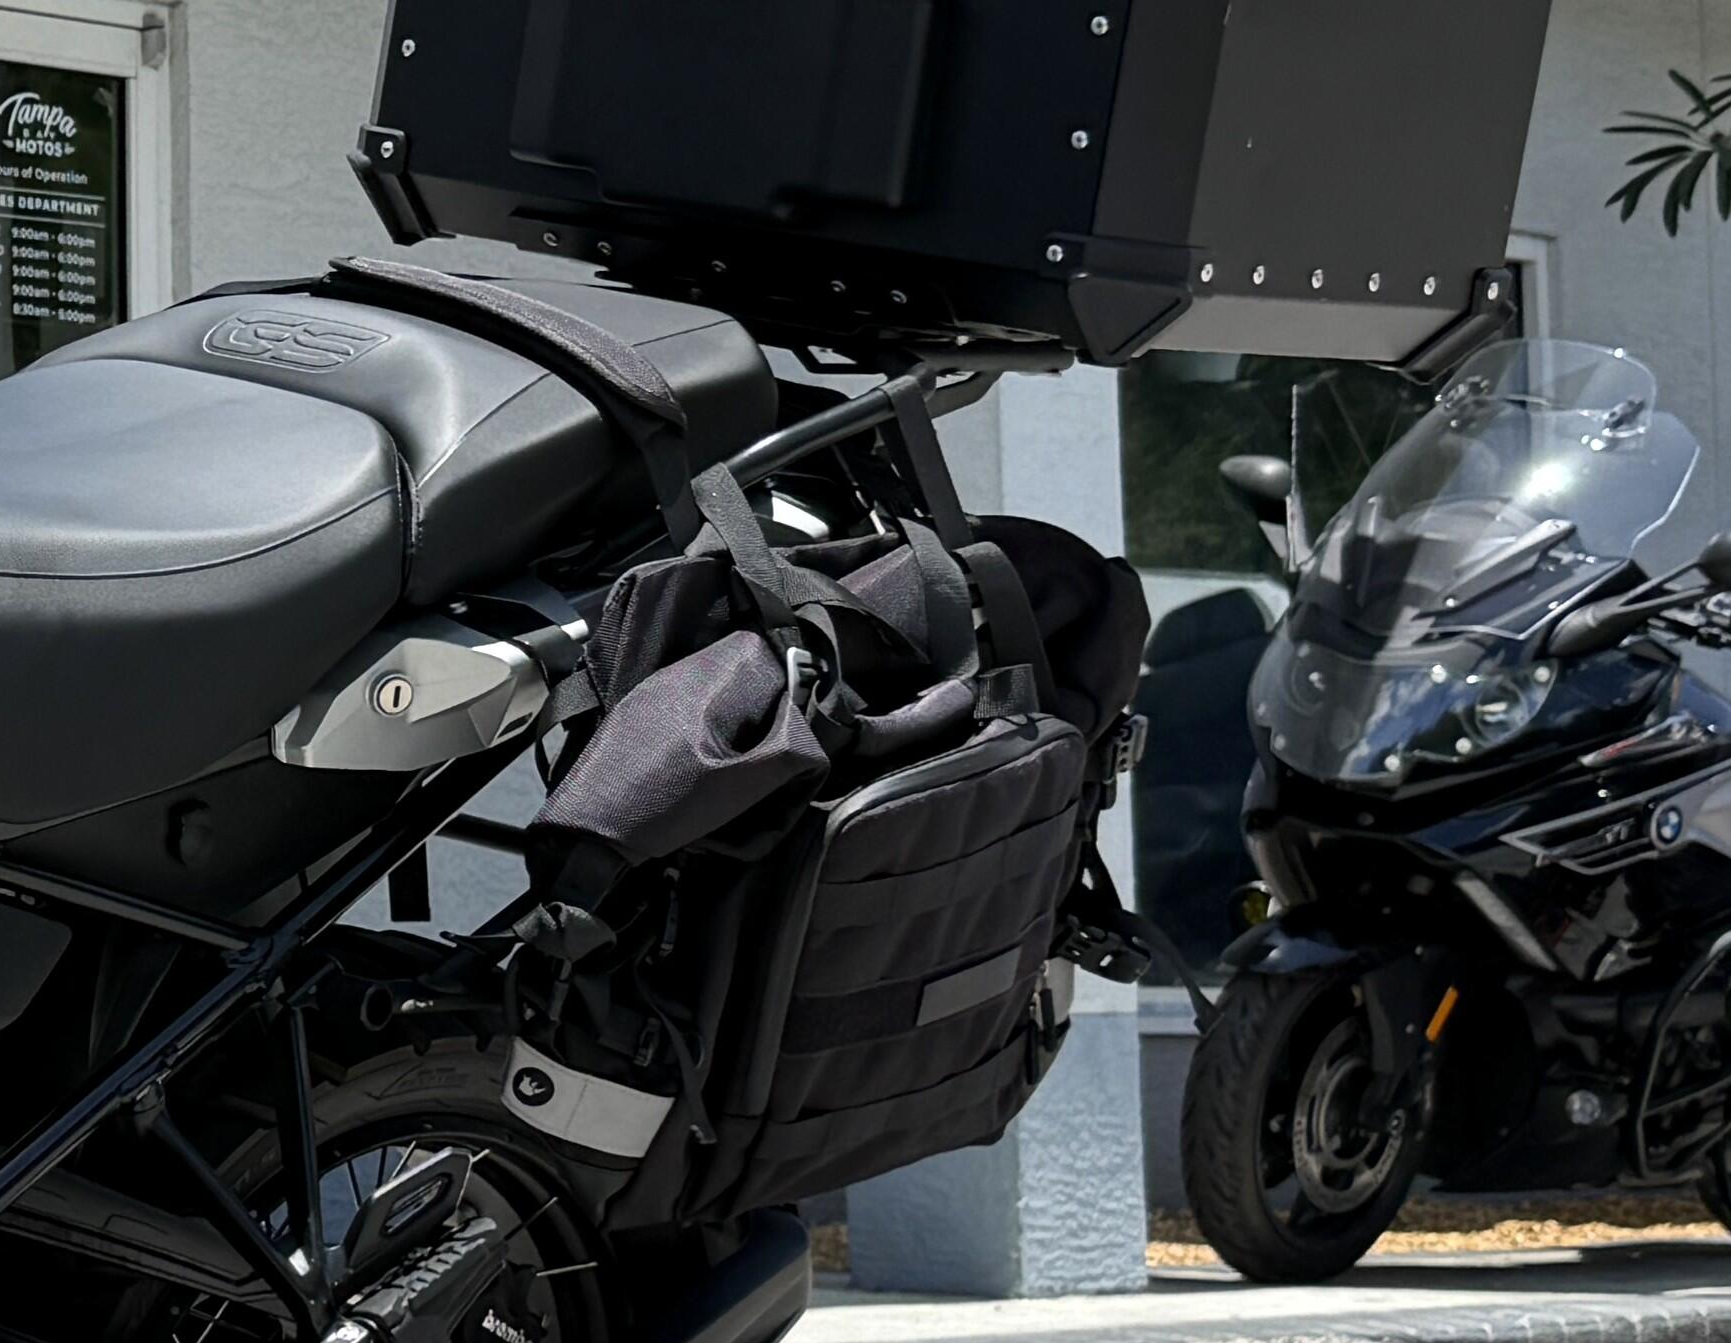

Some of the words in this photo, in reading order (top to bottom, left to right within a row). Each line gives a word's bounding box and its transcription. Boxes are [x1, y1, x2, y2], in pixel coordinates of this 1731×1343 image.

[15, 138, 63, 157] MOTOS
[21, 166, 33, 178] of
[35, 168, 88, 184] Operation
[18, 196, 99, 216] DEPARTMENT
[11, 227, 49, 241] 9:00am
[58, 233, 95, 248] 6:00pm
